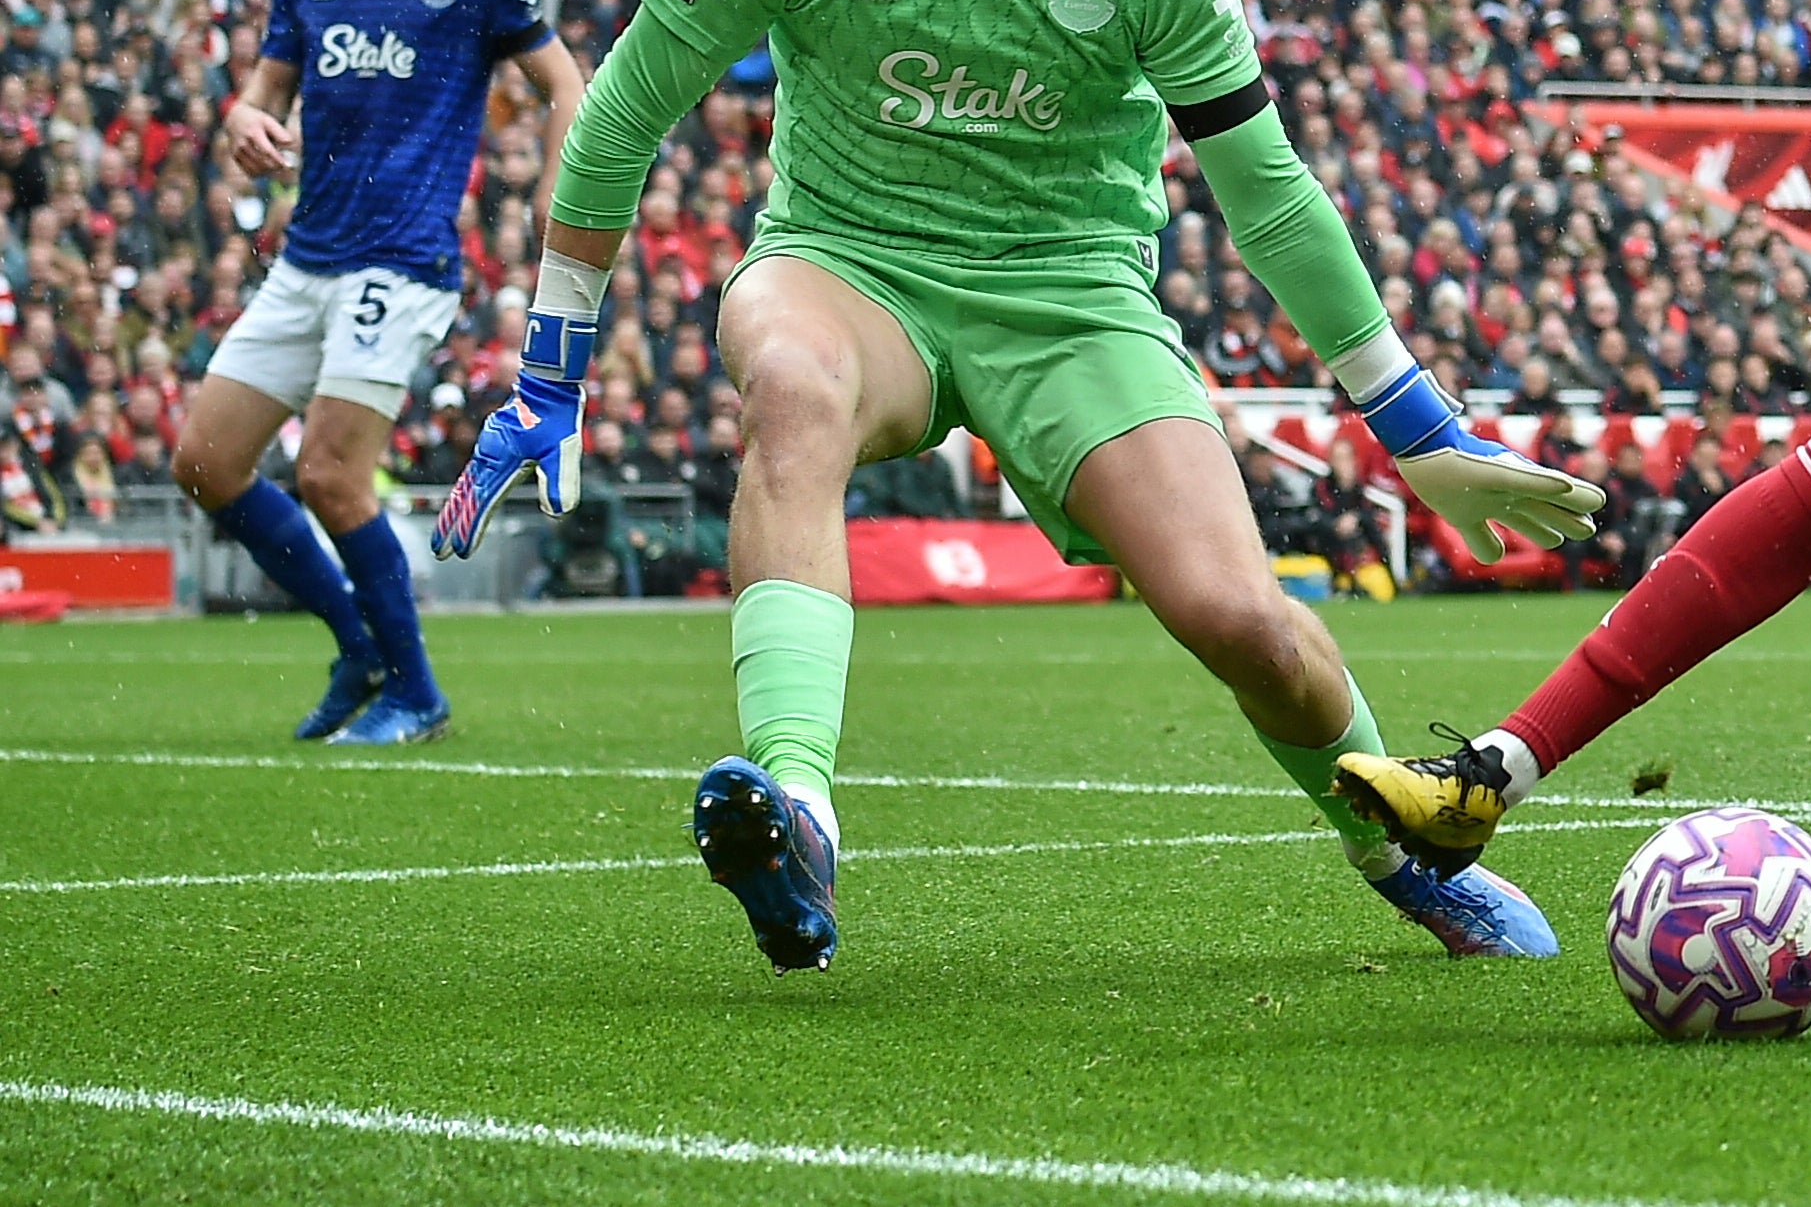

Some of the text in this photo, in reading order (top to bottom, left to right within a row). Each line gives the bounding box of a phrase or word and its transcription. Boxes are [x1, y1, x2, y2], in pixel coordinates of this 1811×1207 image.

[317, 23, 417, 78] Stake
[878, 50, 1066, 131] Stake
[960, 122, 999, 134] .com
[354, 282, 392, 326] 5
